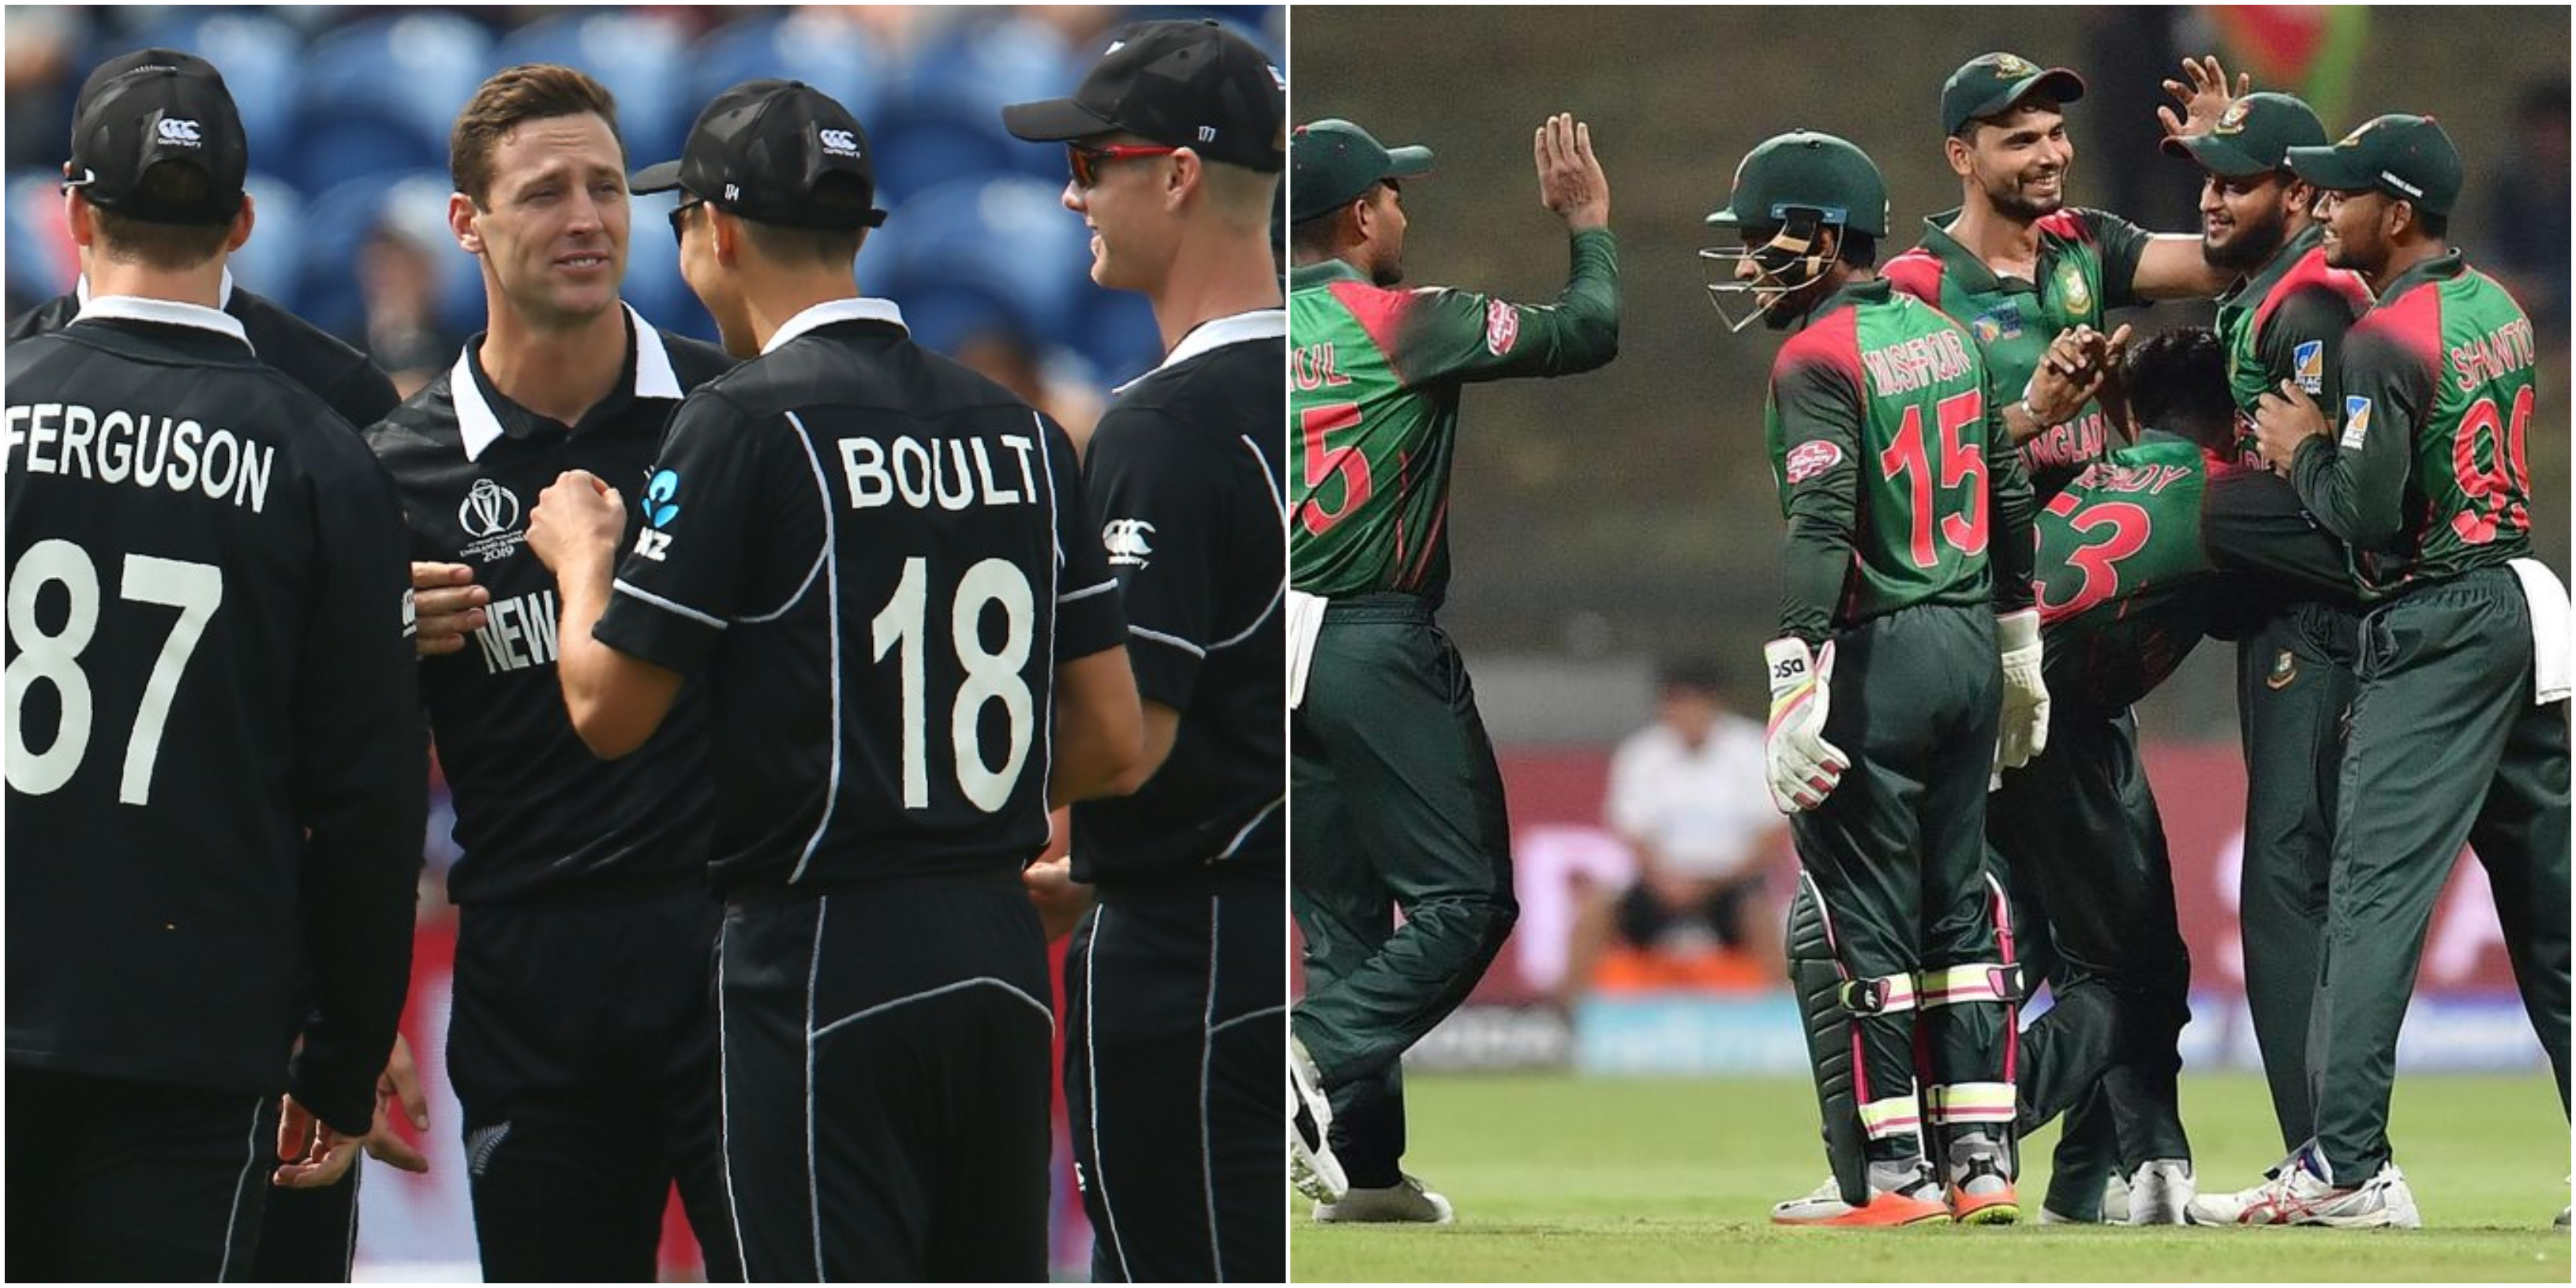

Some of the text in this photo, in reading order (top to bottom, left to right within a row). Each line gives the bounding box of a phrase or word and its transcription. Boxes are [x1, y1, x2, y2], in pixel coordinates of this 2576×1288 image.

[1290, 342, 1352, 391] UL
[6, 403, 275, 515] FERGUSON
[838, 435, 1038, 511] BOULT
[1290, 402, 1372, 537] 5
[1881, 390, 1989, 568] 15
[6, 538, 223, 806] 87
[475, 590, 558, 674] NEW
[871, 556, 1035, 814] 18
